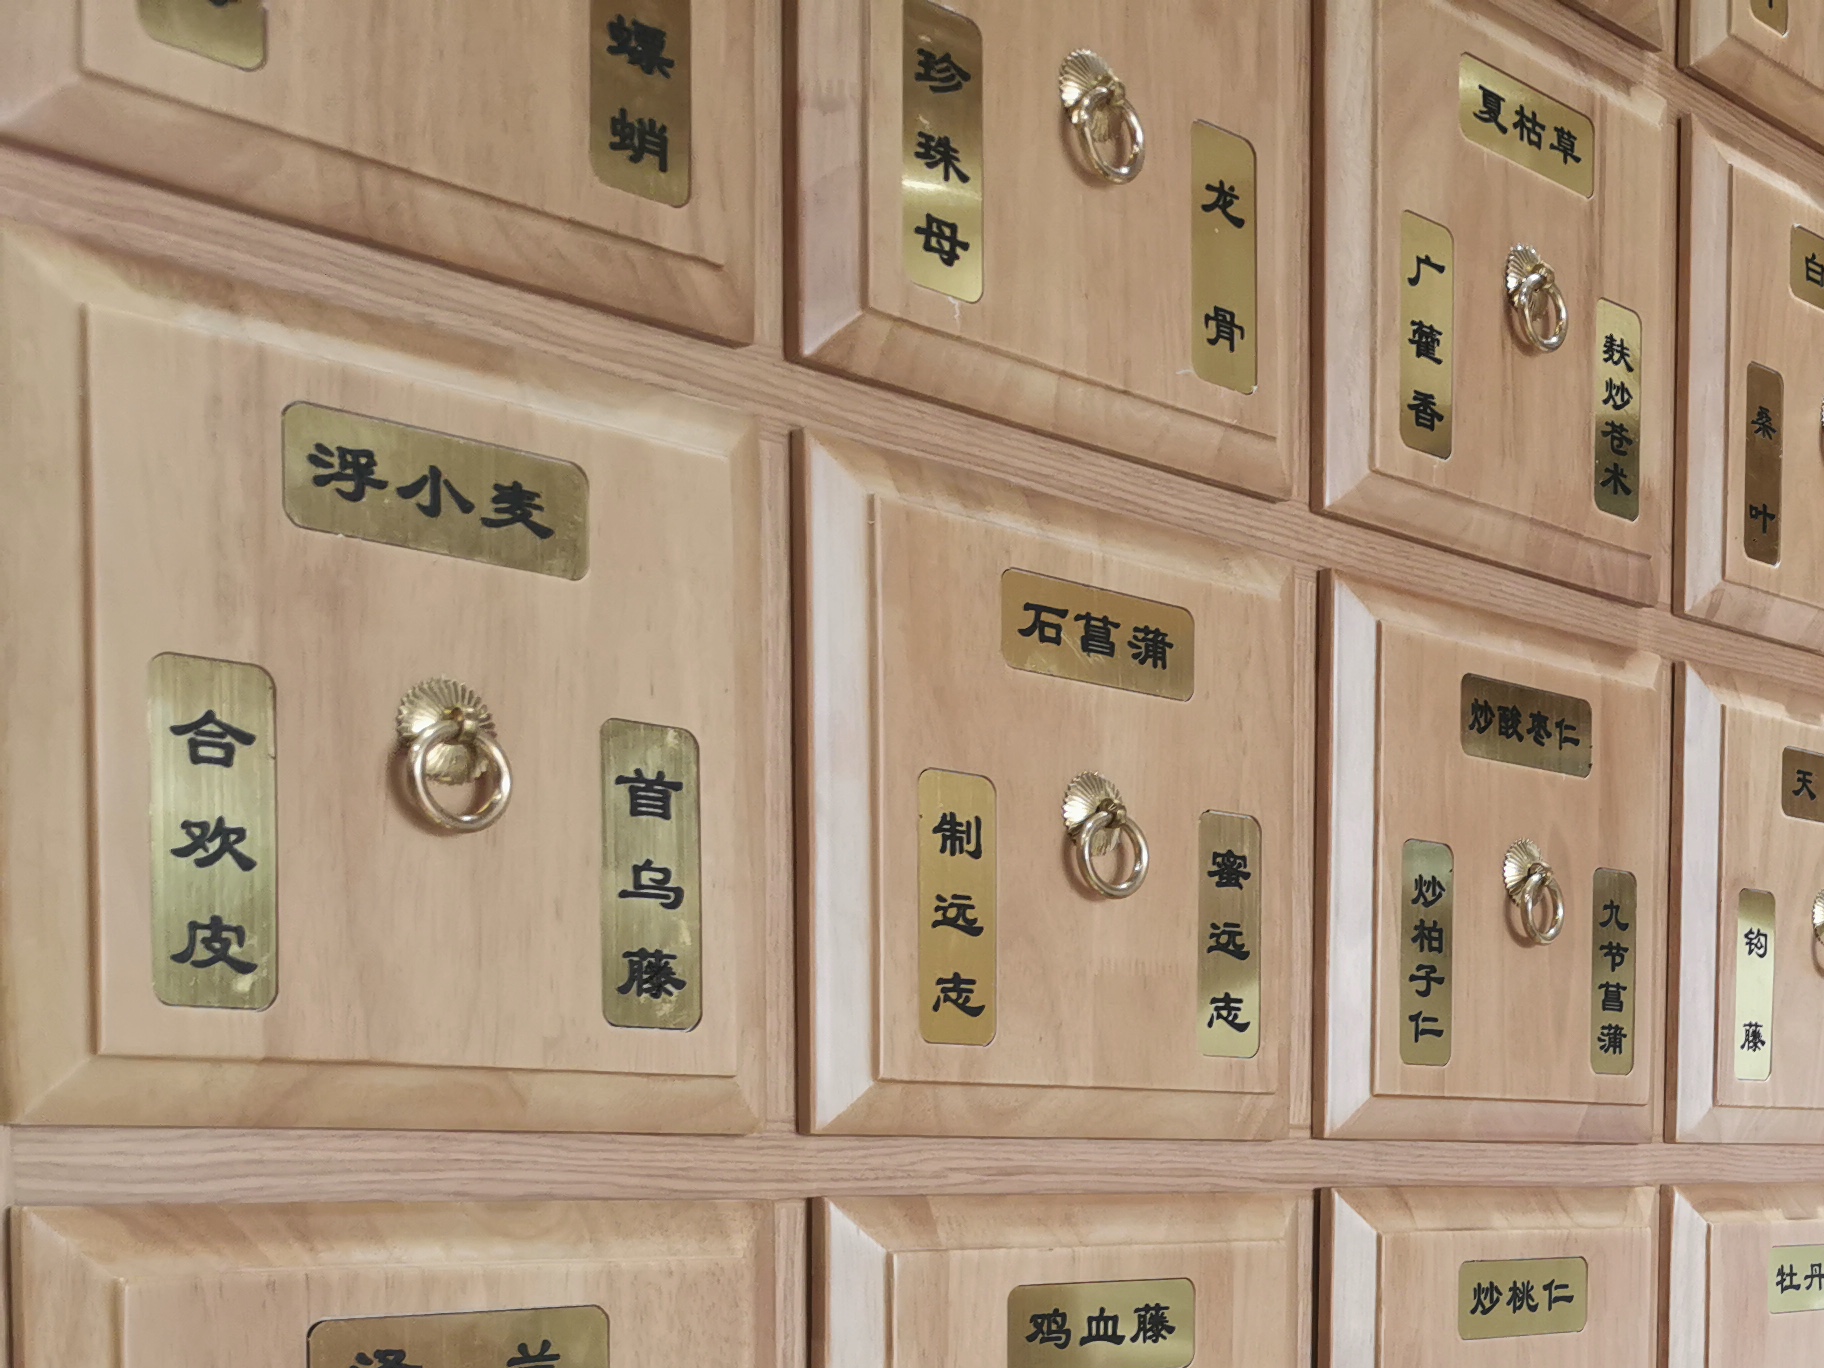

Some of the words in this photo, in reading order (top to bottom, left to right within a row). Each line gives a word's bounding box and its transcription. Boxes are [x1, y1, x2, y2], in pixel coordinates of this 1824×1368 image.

[914, 48, 970, 267] 珍珠母
[1473, 84, 1581, 165] 夏枯草
[1201, 179, 1245, 352] 龙骨
[1407, 255, 1445, 433] 广藿香
[307, 443, 555, 540] 浮小麦
[1601, 334, 1634, 497] 麸炒苍术
[1750, 406, 1776, 534] 桑叶
[1018, 602, 1174, 670] 石菖蒲
[1468, 698, 1580, 748] 炒酸枣仁
[170, 709, 258, 975] 合欢皮
[614, 769, 686, 999] 首乌藤
[932, 811, 986, 1018] 制远志
[1207, 849, 1251, 1033] 蜜远志
[1408, 875, 1445, 1043] 炒柏子仁
[1597, 901, 1629, 1056] 九节菖蒲
[1741, 927, 1767, 1052] 钩藤
[1025, 1302, 1175, 1350] 鸡血藤
[1469, 1279, 1574, 1316] 炒桃仁
